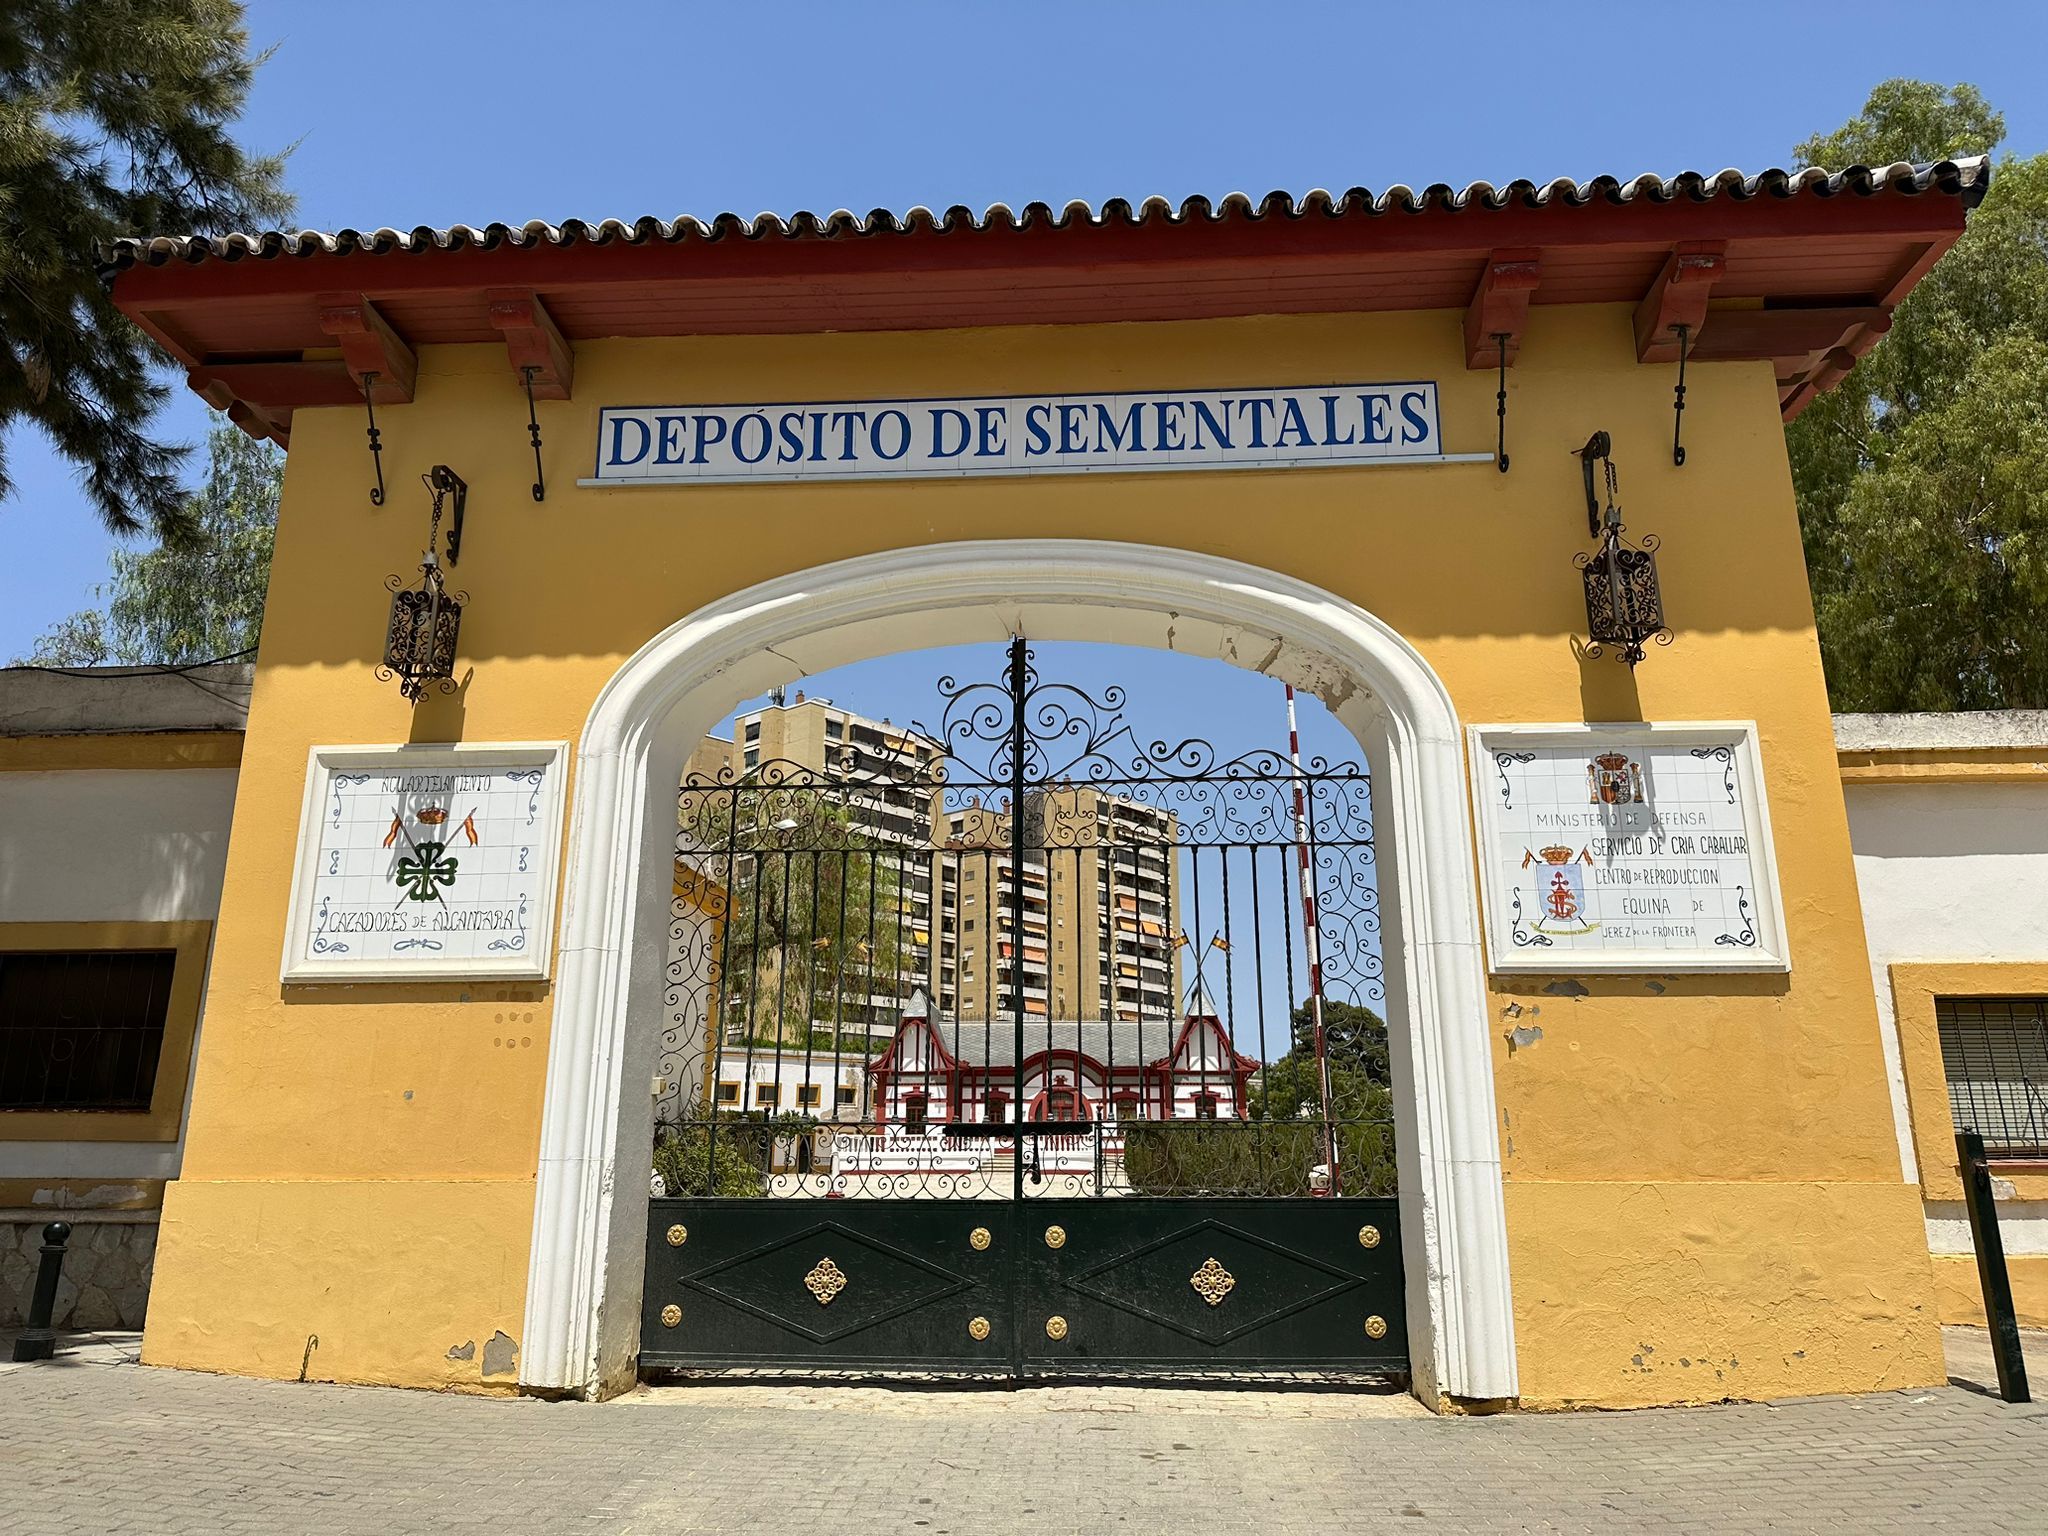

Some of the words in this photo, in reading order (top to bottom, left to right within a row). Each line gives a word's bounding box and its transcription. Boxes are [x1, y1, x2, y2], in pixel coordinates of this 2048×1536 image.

[606, 408, 912, 466] DEPÓSITO
[927, 406, 1007, 459] DE
[1024, 389, 1429, 458] SEMENTALES
[381, 774, 491, 794] ACUARTELAMIENTO
[1536, 813, 1617, 827] MINISTERIO
[1626, 813, 1639, 826] DE
[1652, 812, 1707, 826] DEFENSA
[1592, 837, 1642, 856] SERVICIO
[1650, 837, 1663, 855] DE
[1671, 836, 1695, 855] CRIA
[1700, 836, 1748, 855] CABALLAR
[1595, 868, 1631, 885] CENTRO
[1633, 872, 1642, 882] DE
[1643, 868, 1719, 885] REPRODUCCION
[1622, 897, 1671, 915] EQUINA
[1692, 900, 1705, 912] DE
[329, 911, 408, 932] CAZADORES
[411, 915, 427, 928] DE
[432, 909, 514, 931] ALCANTARA
[1602, 926, 1631, 938] JEREZ
[1652, 926, 1697, 938] FRONTERA
